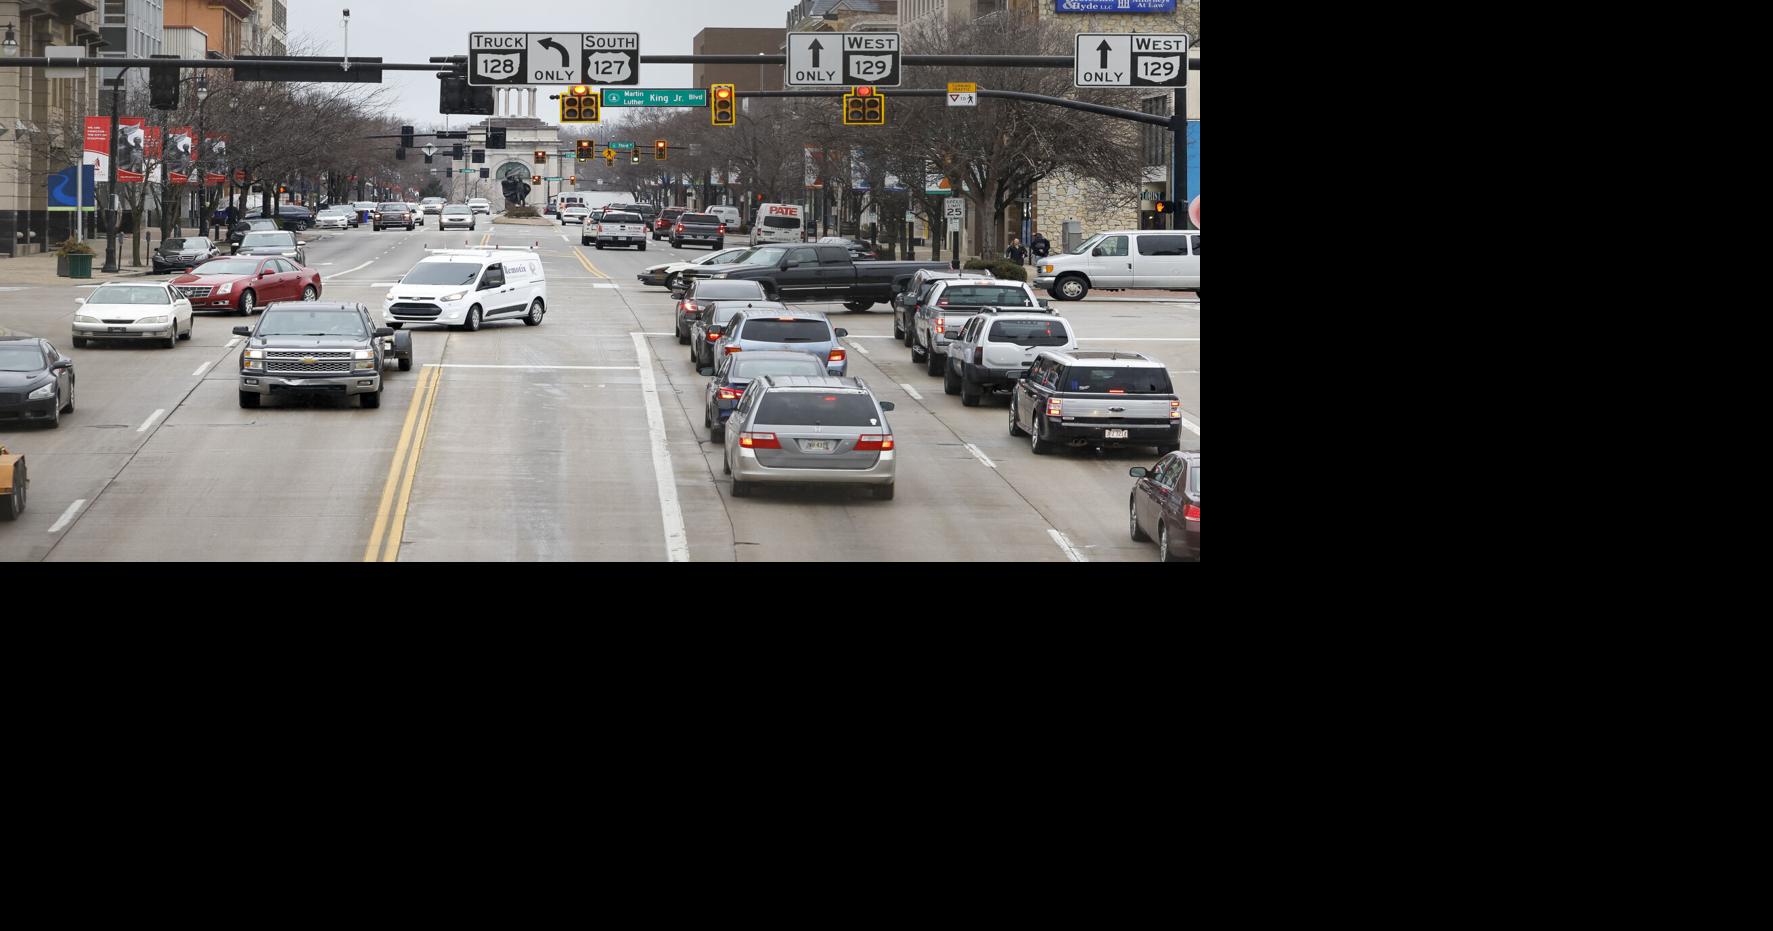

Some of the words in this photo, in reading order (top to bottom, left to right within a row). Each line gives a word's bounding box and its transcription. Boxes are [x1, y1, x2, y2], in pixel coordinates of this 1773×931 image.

[1072, 2, 1099, 11] Hyde
[474, 35, 523, 48] TRUCK
[585, 35, 635, 48] SOUTH
[847, 36, 895, 49] WEST
[1135, 38, 1182, 50] WEST
[483, 59, 514, 74] 128
[594, 60, 625, 75] 127
[855, 60, 886, 75] 129
[1143, 62, 1174, 76] 129
[534, 70, 575, 81] ONLY
[796, 70, 836, 81] ONLY
[1084, 72, 1123, 82] ONLY
[649, 94, 669, 104] King
[673, 94, 685, 102] Jr.
[769, 206, 798, 216] PATE
[947, 208, 962, 216] 25
